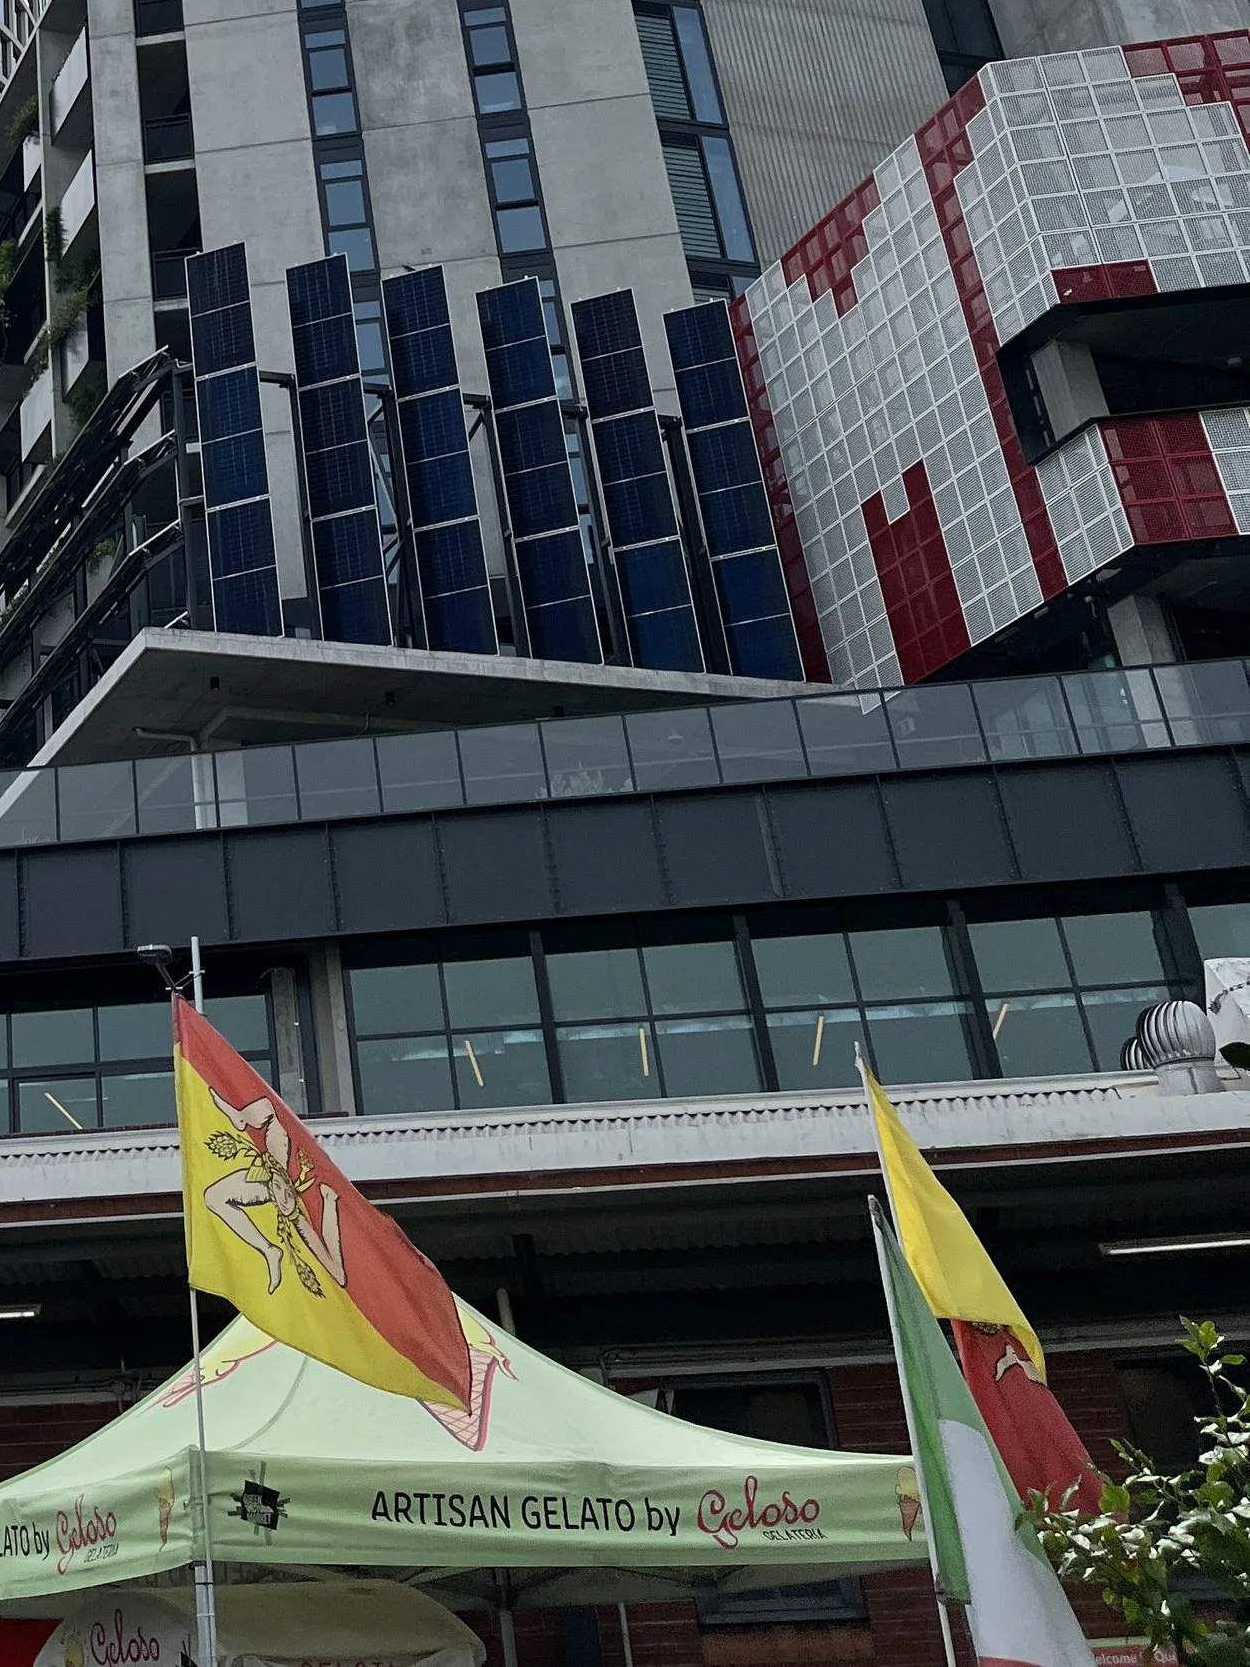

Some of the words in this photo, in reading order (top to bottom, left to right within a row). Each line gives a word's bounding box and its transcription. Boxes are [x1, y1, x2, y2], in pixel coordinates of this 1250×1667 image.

[32, 1522, 51, 1561] by
[56, 1493, 118, 1575] Geloso
[371, 1491, 511, 1530] ARTISAN
[521, 1496, 636, 1532] GELATO
[644, 1496, 681, 1537] by
[697, 1475, 821, 1550] Geloso
[762, 1528, 829, 1542] GELATERIA
[1094, 1650, 1138, 1665] elcome
